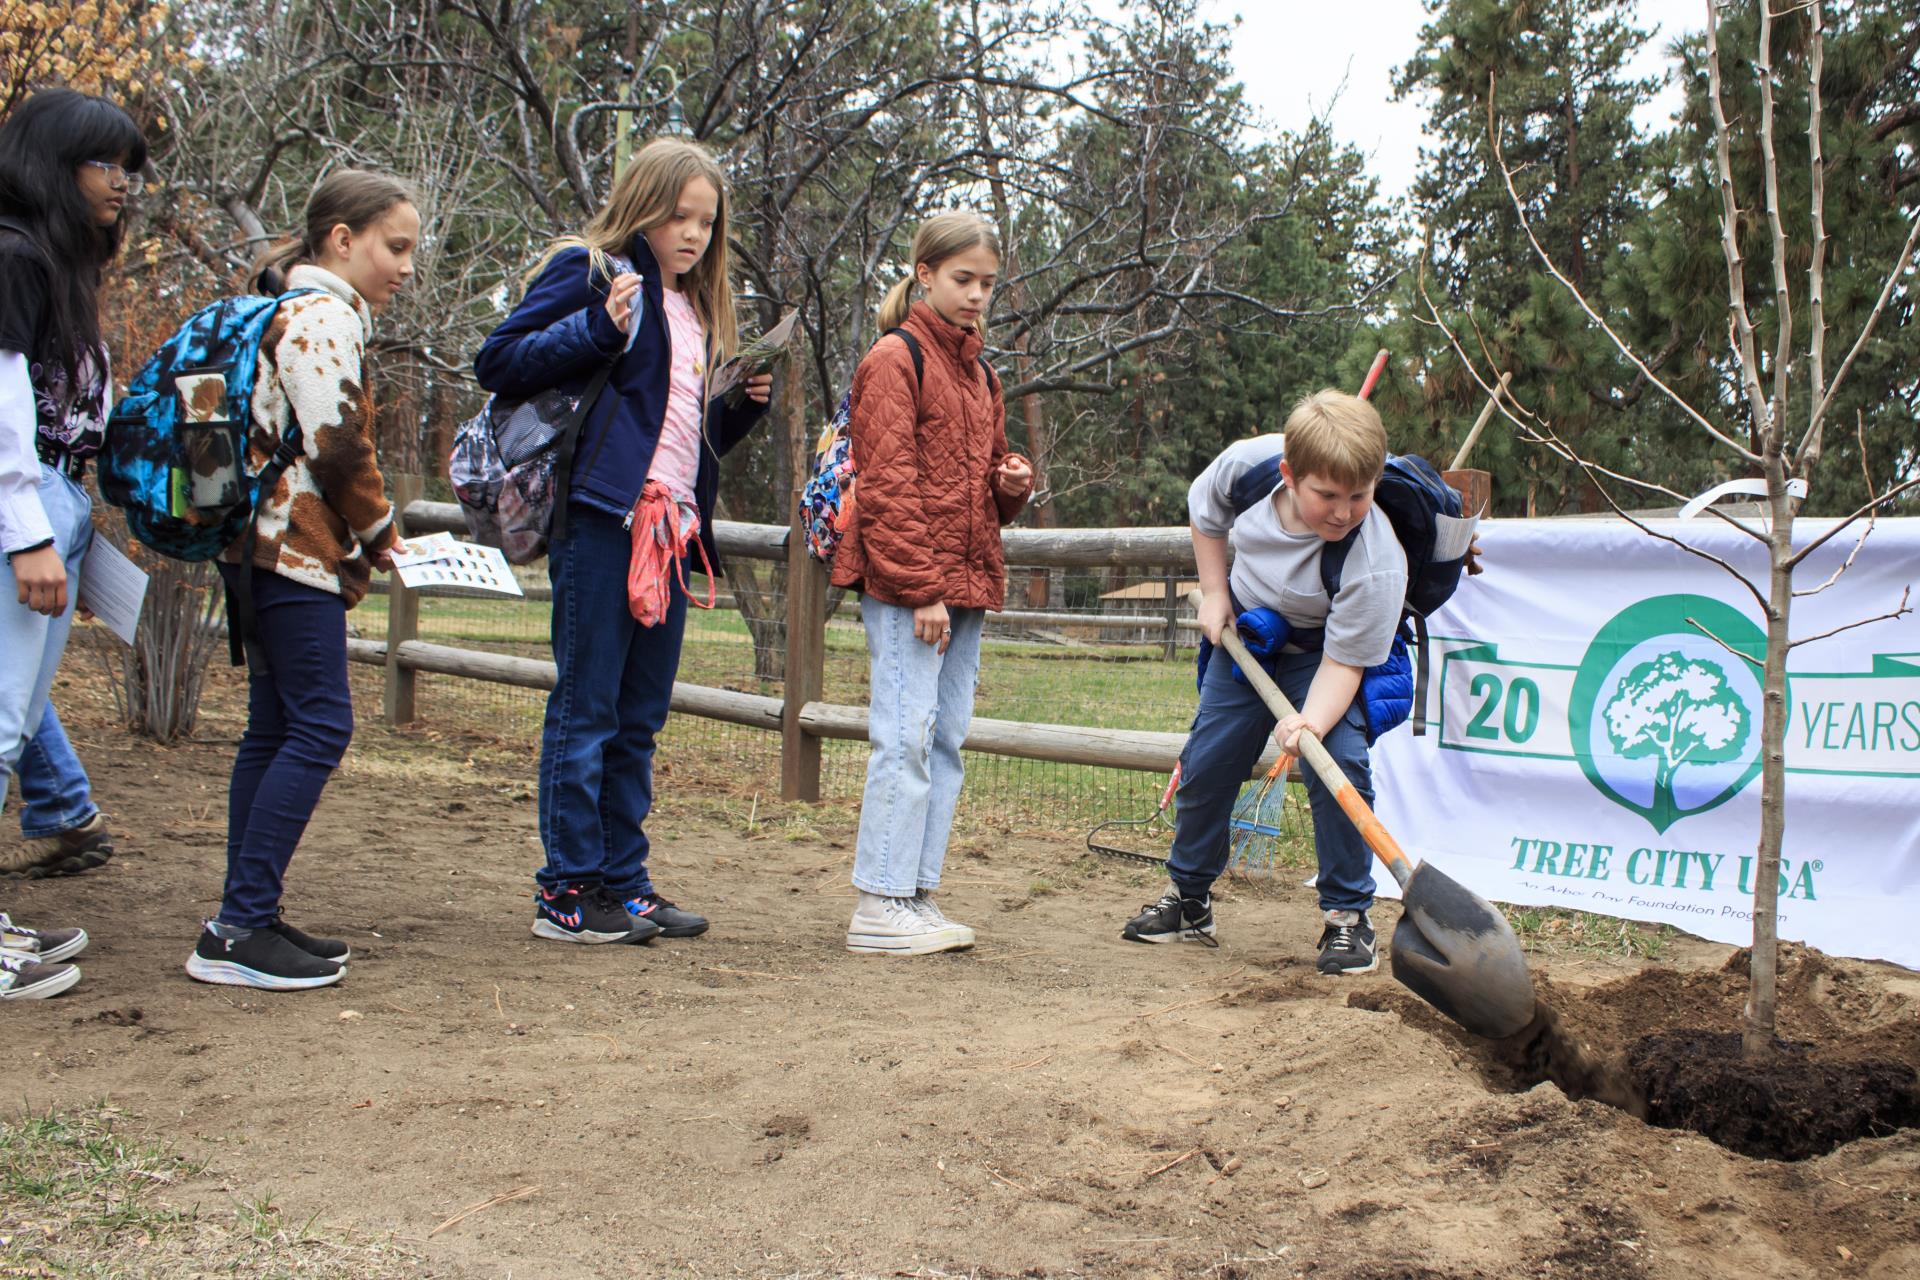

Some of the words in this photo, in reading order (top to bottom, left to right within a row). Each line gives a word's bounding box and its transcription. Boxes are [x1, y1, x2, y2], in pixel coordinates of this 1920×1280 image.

[1466, 673, 1540, 744] 20
[1801, 701, 1920, 752] YEARS
[1509, 836, 1613, 881] TREE
[1626, 848, 1725, 891] CITY
[1628, 895, 1715, 915] Foundation
[1721, 905, 1787, 922] Progm
